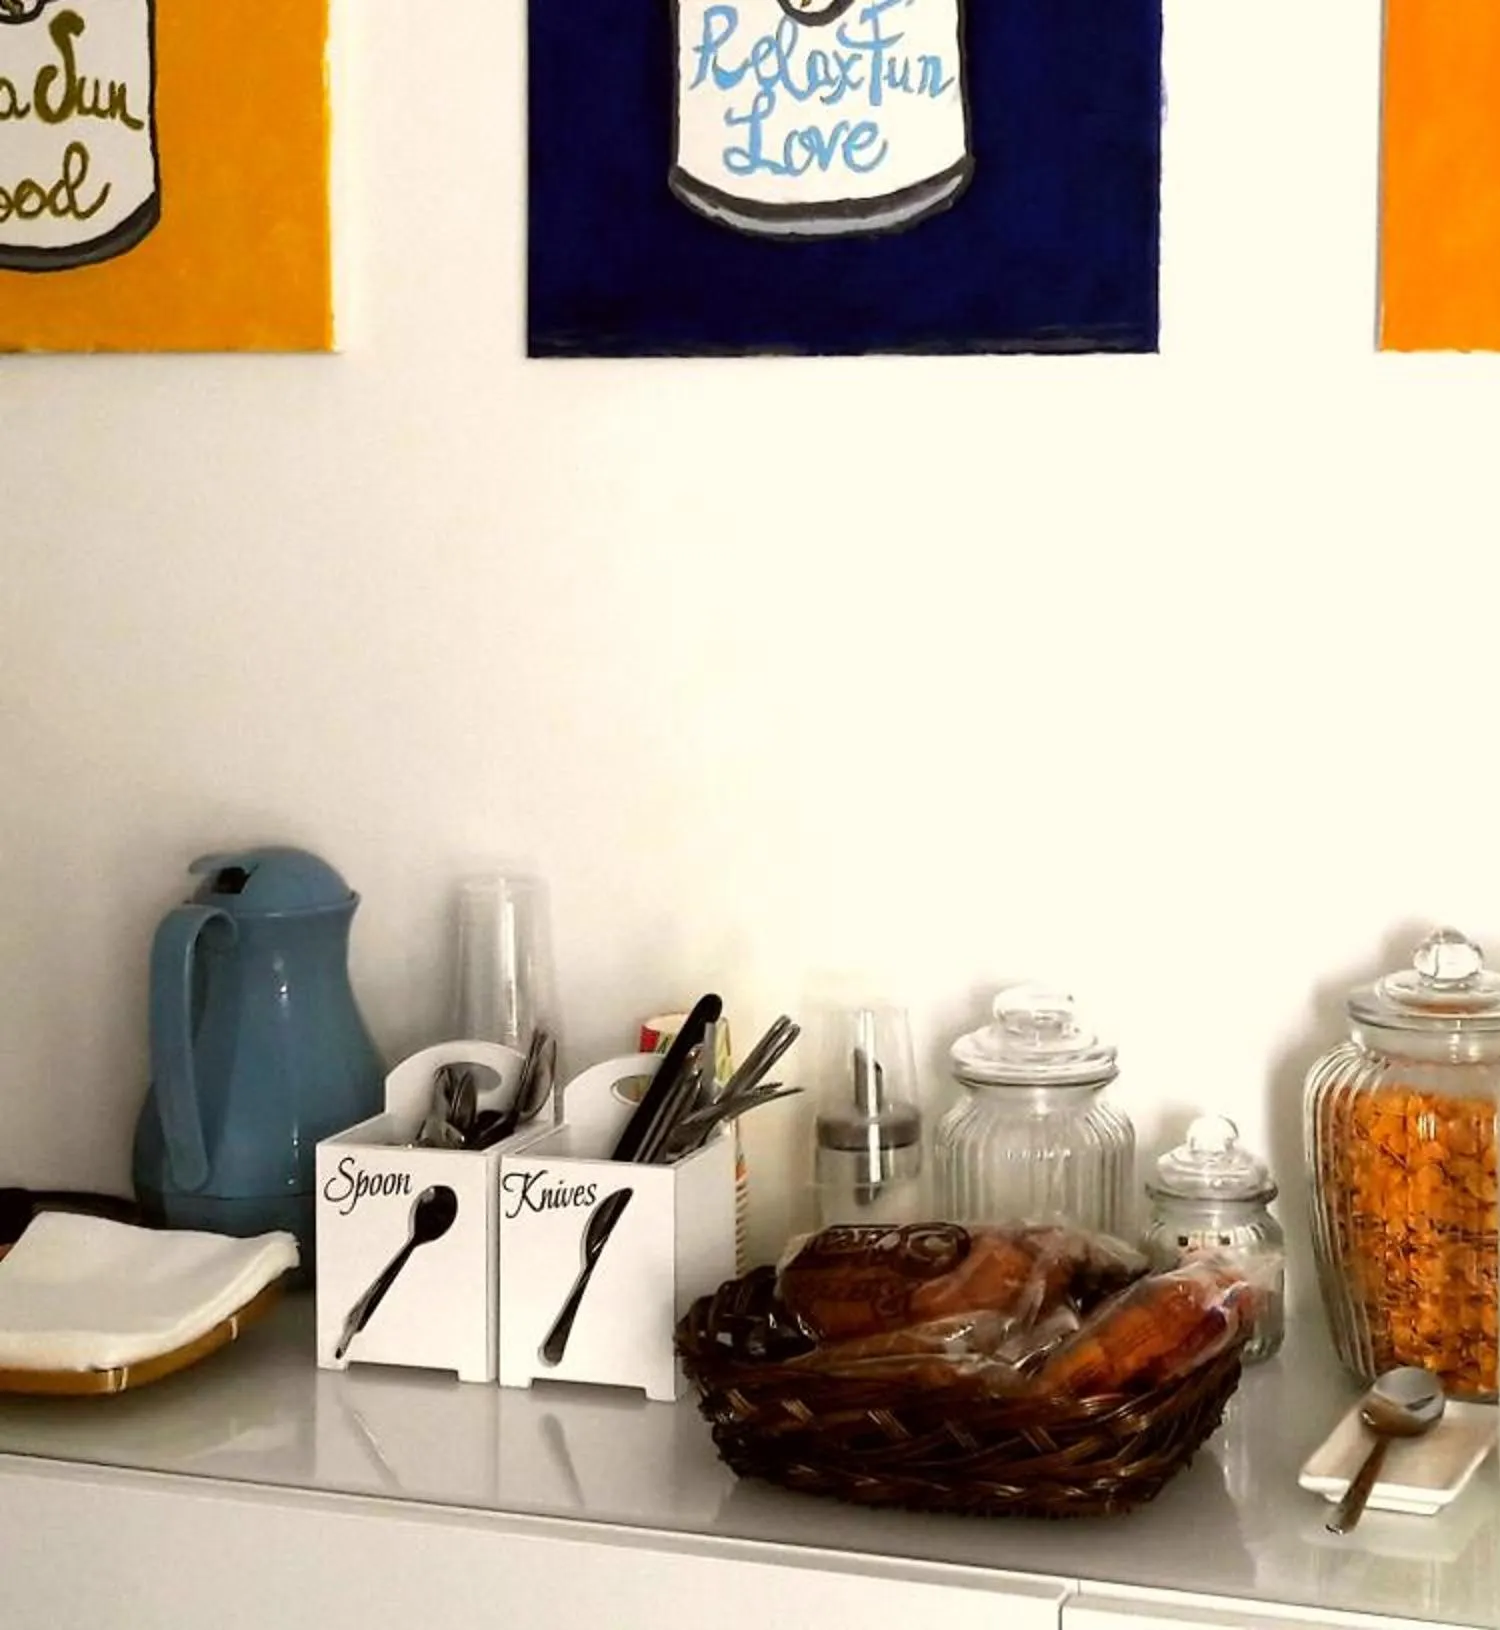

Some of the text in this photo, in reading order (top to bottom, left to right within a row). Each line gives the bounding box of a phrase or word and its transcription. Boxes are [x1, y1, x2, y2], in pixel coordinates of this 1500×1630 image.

[34, 10, 144, 130] Sun
[689, 0, 955, 106] Relax Fun
[723, 90, 888, 176] Love
[323, 1157, 412, 1216] Spoon
[502, 1170, 598, 1219] Knives
